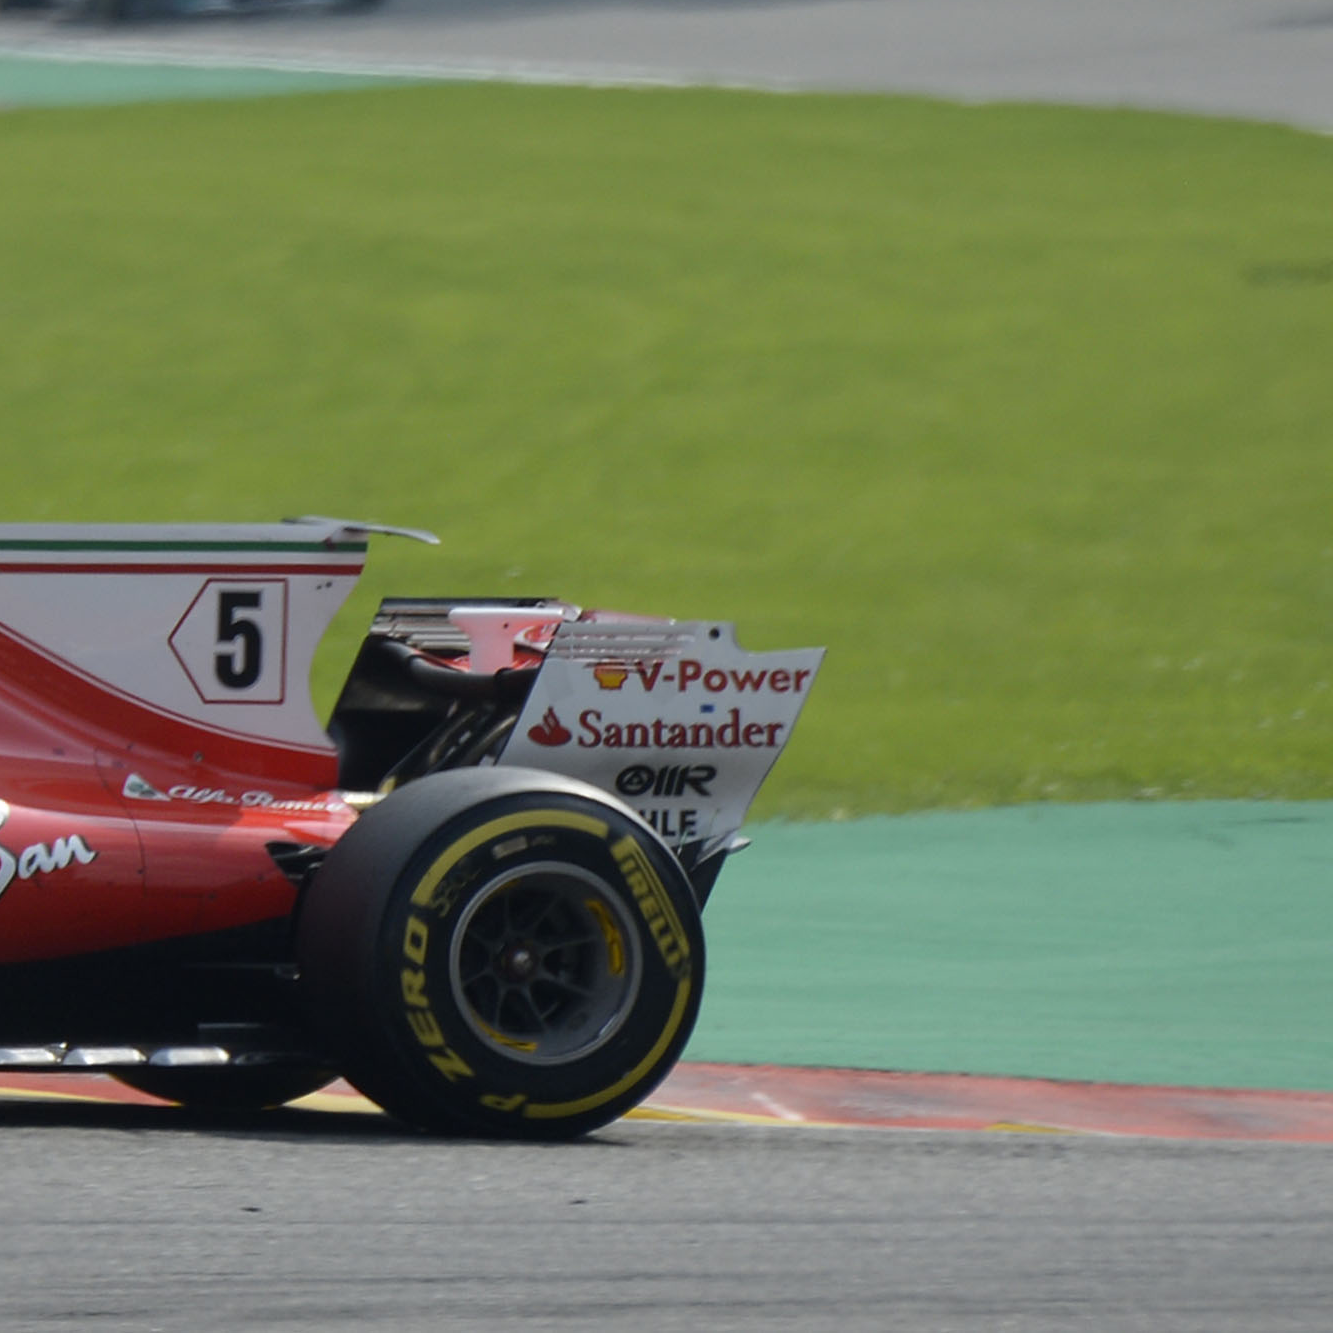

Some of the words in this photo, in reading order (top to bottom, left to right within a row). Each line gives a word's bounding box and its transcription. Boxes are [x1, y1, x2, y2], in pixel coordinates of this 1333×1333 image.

[214, 589, 263, 690] 5
[636, 660, 810, 693] V-Power
[577, 707, 784, 748] Santander
[610, 834, 691, 973] PIRELLI
